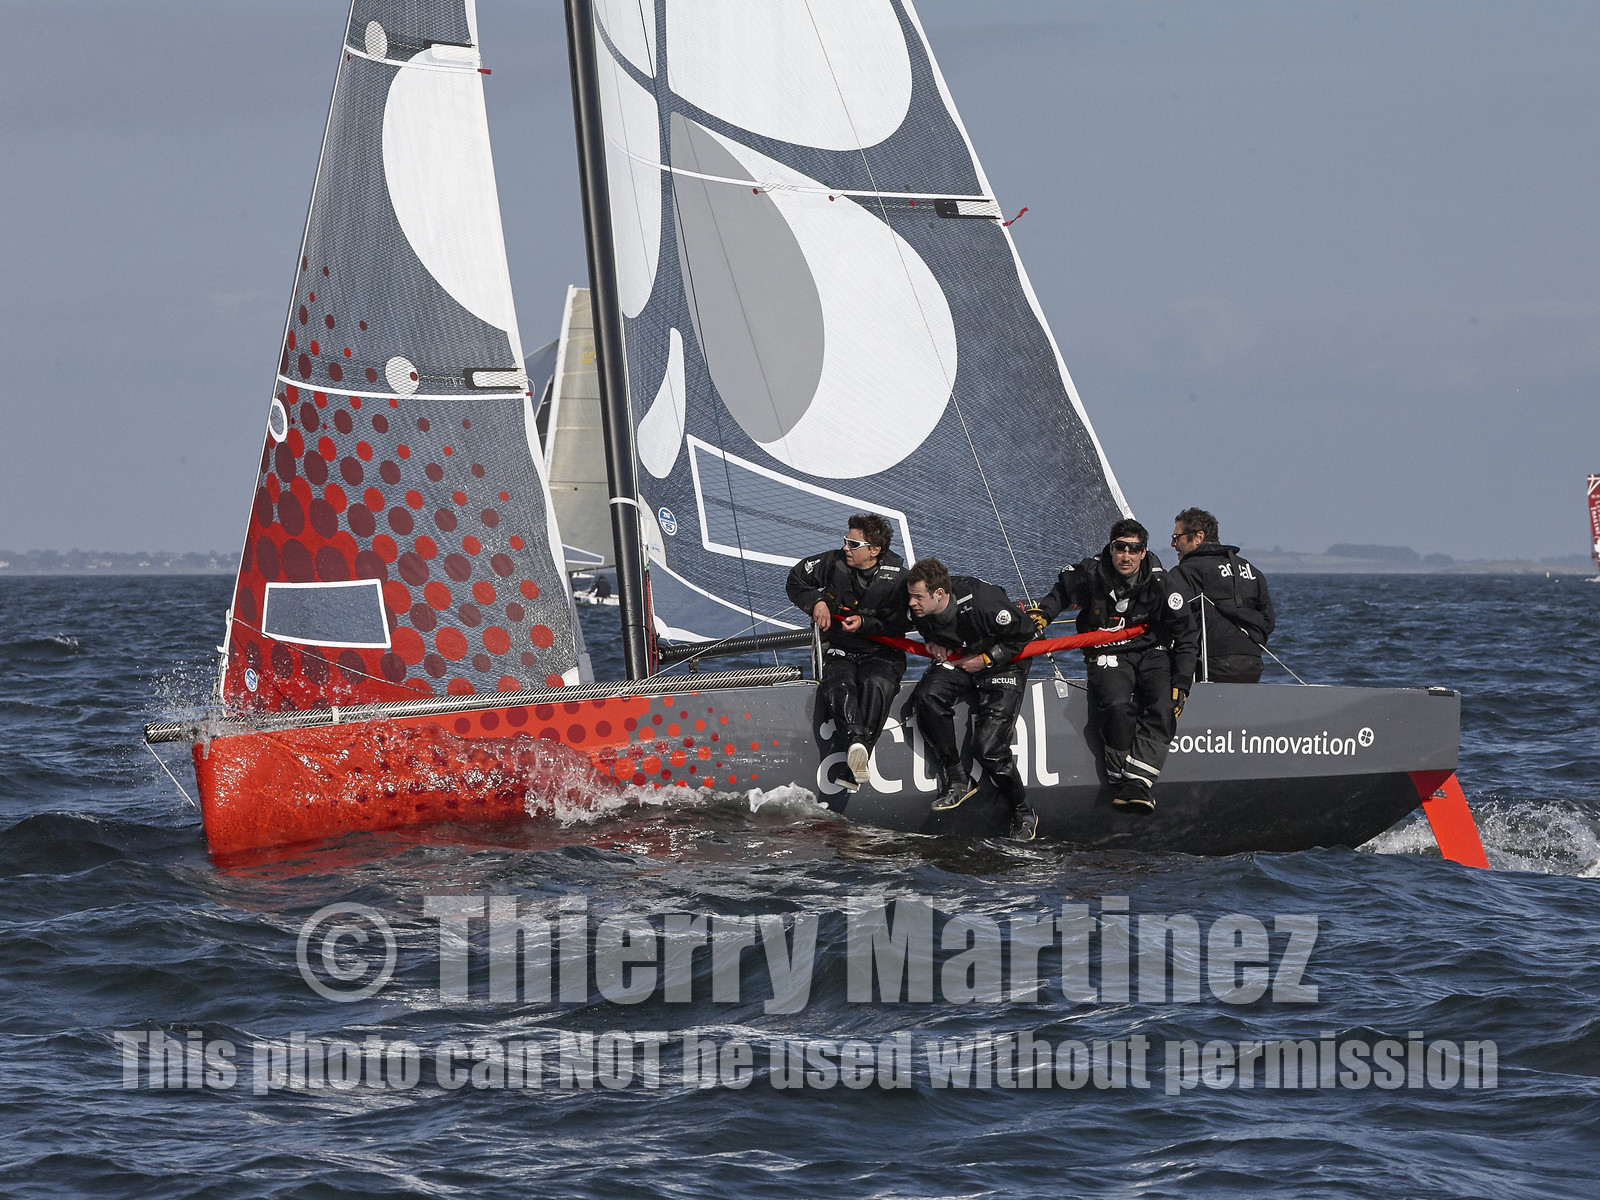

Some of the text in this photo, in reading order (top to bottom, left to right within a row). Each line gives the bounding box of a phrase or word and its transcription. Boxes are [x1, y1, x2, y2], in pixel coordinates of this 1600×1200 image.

[991, 676, 1018, 686] actual
[1168, 728, 1356, 756] social innovation
